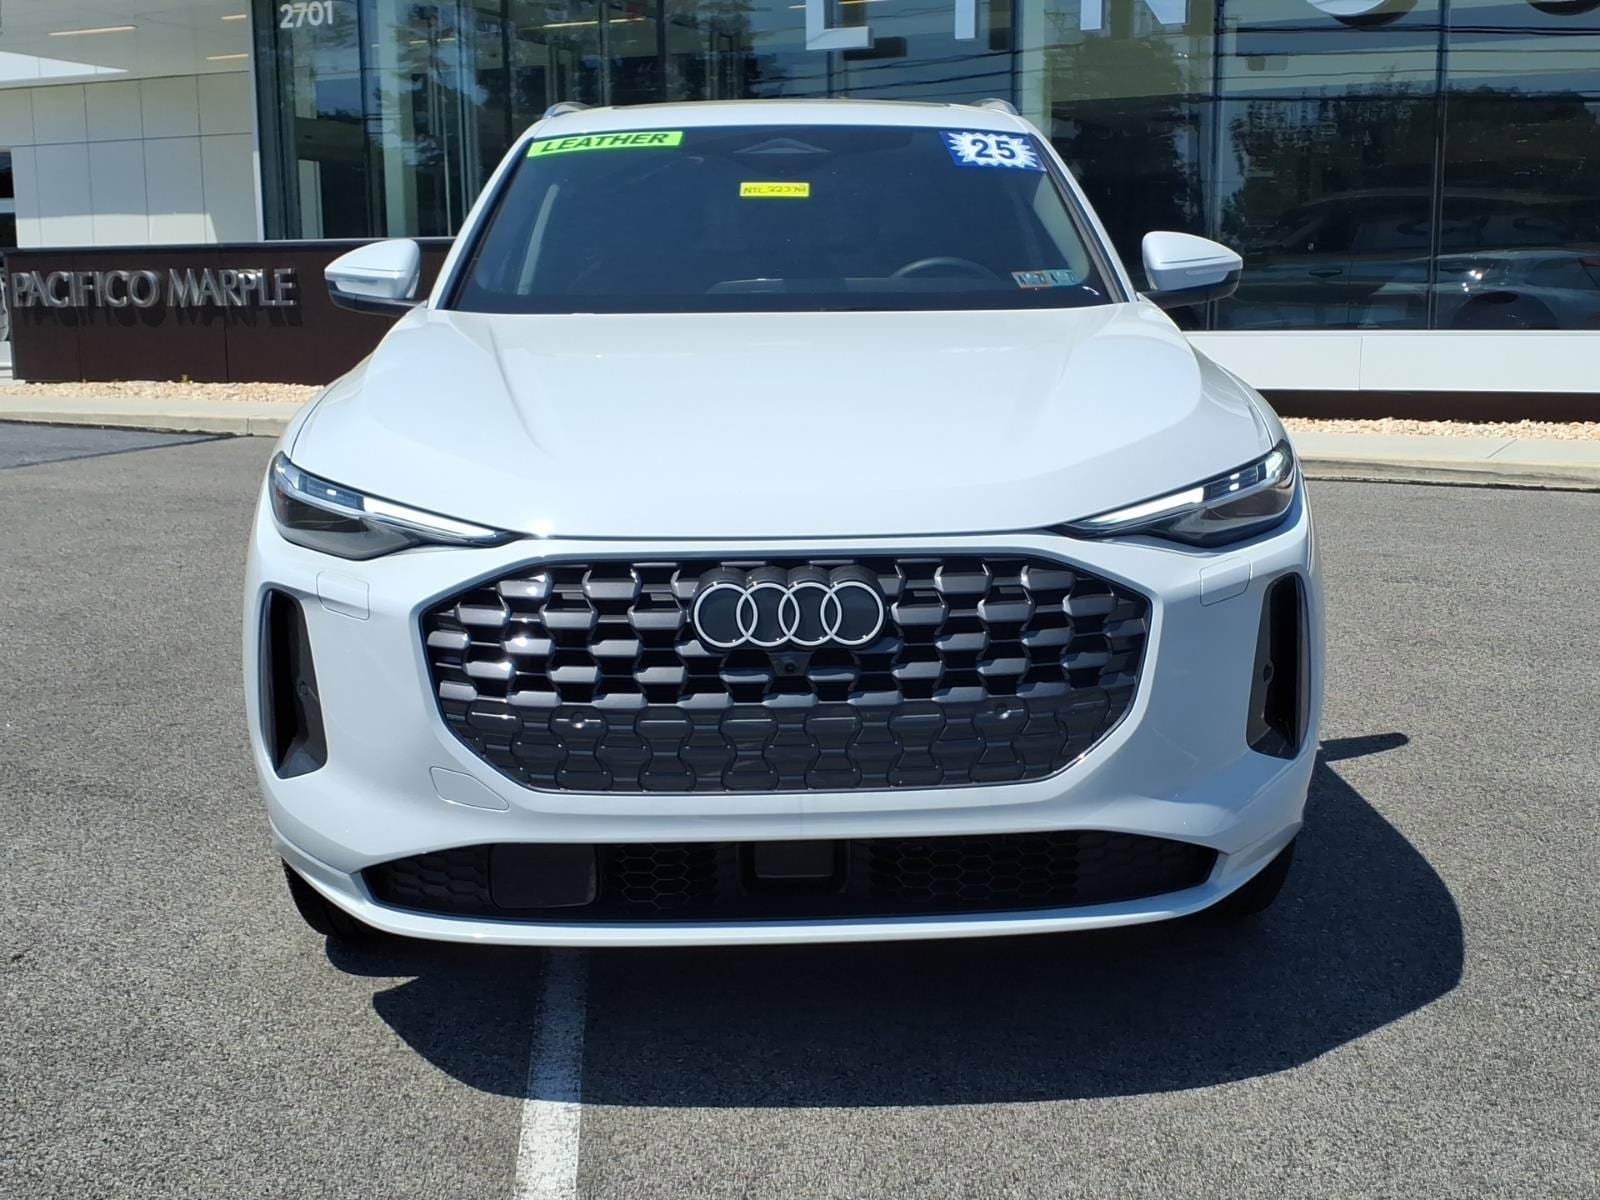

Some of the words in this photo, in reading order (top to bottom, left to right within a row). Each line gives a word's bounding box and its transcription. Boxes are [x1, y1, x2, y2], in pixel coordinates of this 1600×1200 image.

[280, 1, 334, 28] 2701
[541, 133, 669, 152] LEATHER
[970, 138, 1016, 159] 25
[11, 270, 159, 307] PACIFICO
[168, 267, 296, 307] MARPLE
